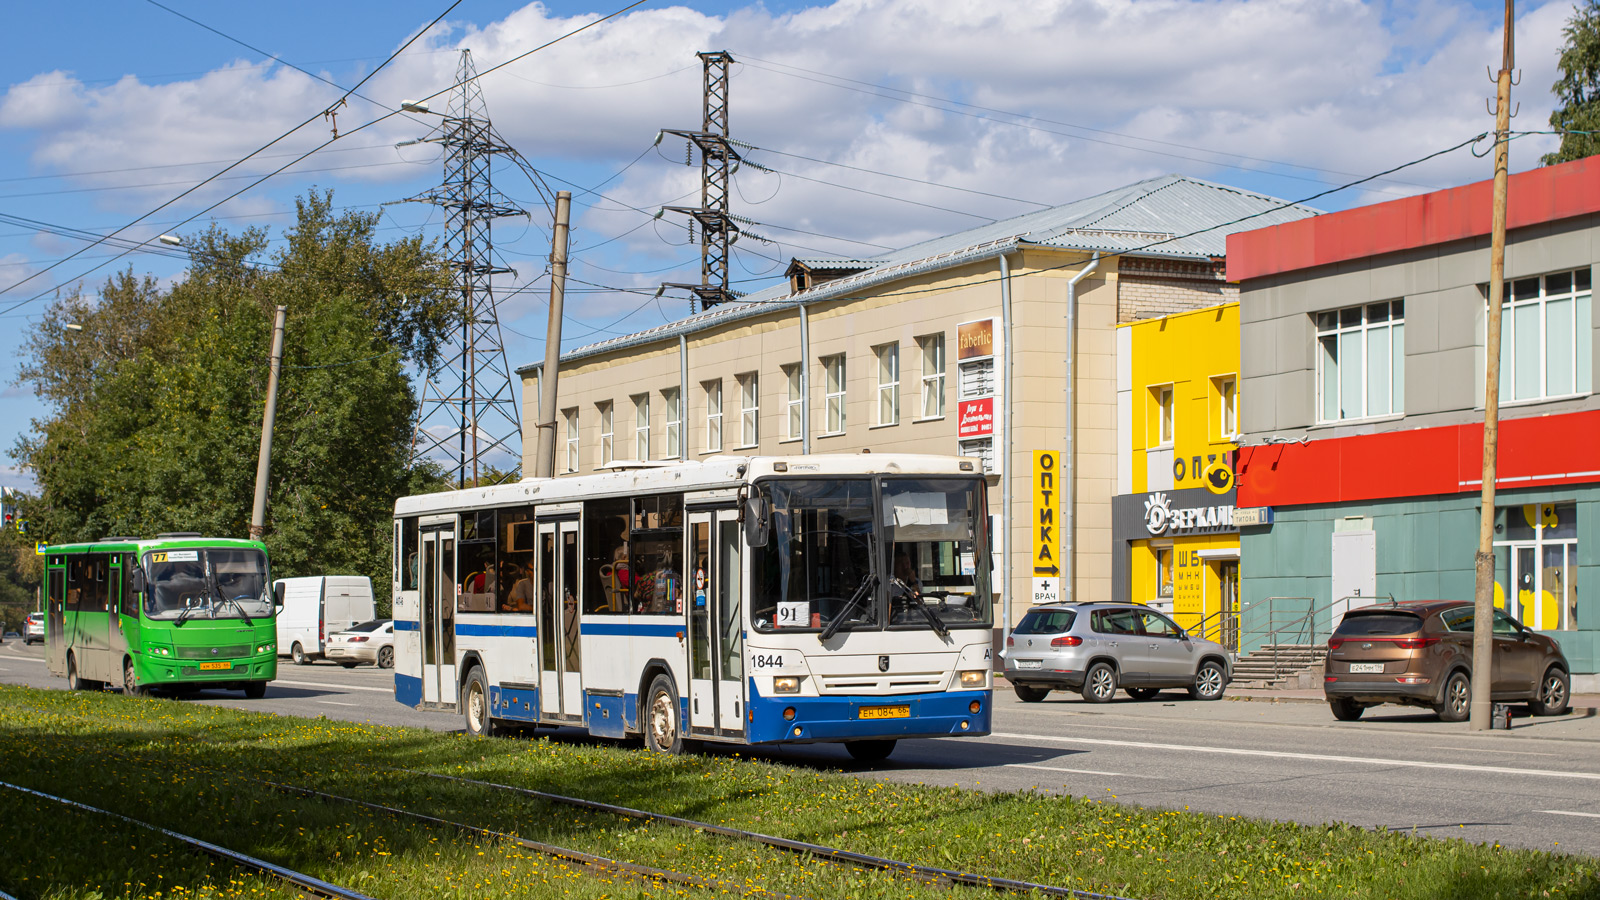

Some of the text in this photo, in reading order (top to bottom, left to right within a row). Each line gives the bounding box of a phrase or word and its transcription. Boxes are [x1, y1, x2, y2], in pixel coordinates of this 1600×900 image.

[960, 330, 992, 349] faberlic
[1038, 453, 1054, 561] ОПТИКА
[1236, 515, 1255, 523] ТИТОВА
[1260, 510, 1266, 522] 1
[153, 553, 167, 562] 77
[1034, 592, 1056, 601] ВРАЧ
[781, 607, 796, 621] 91
[752, 655, 783, 668] 1844
[863, 710, 874, 718] ЕН
[878, 707, 894, 717] 084
